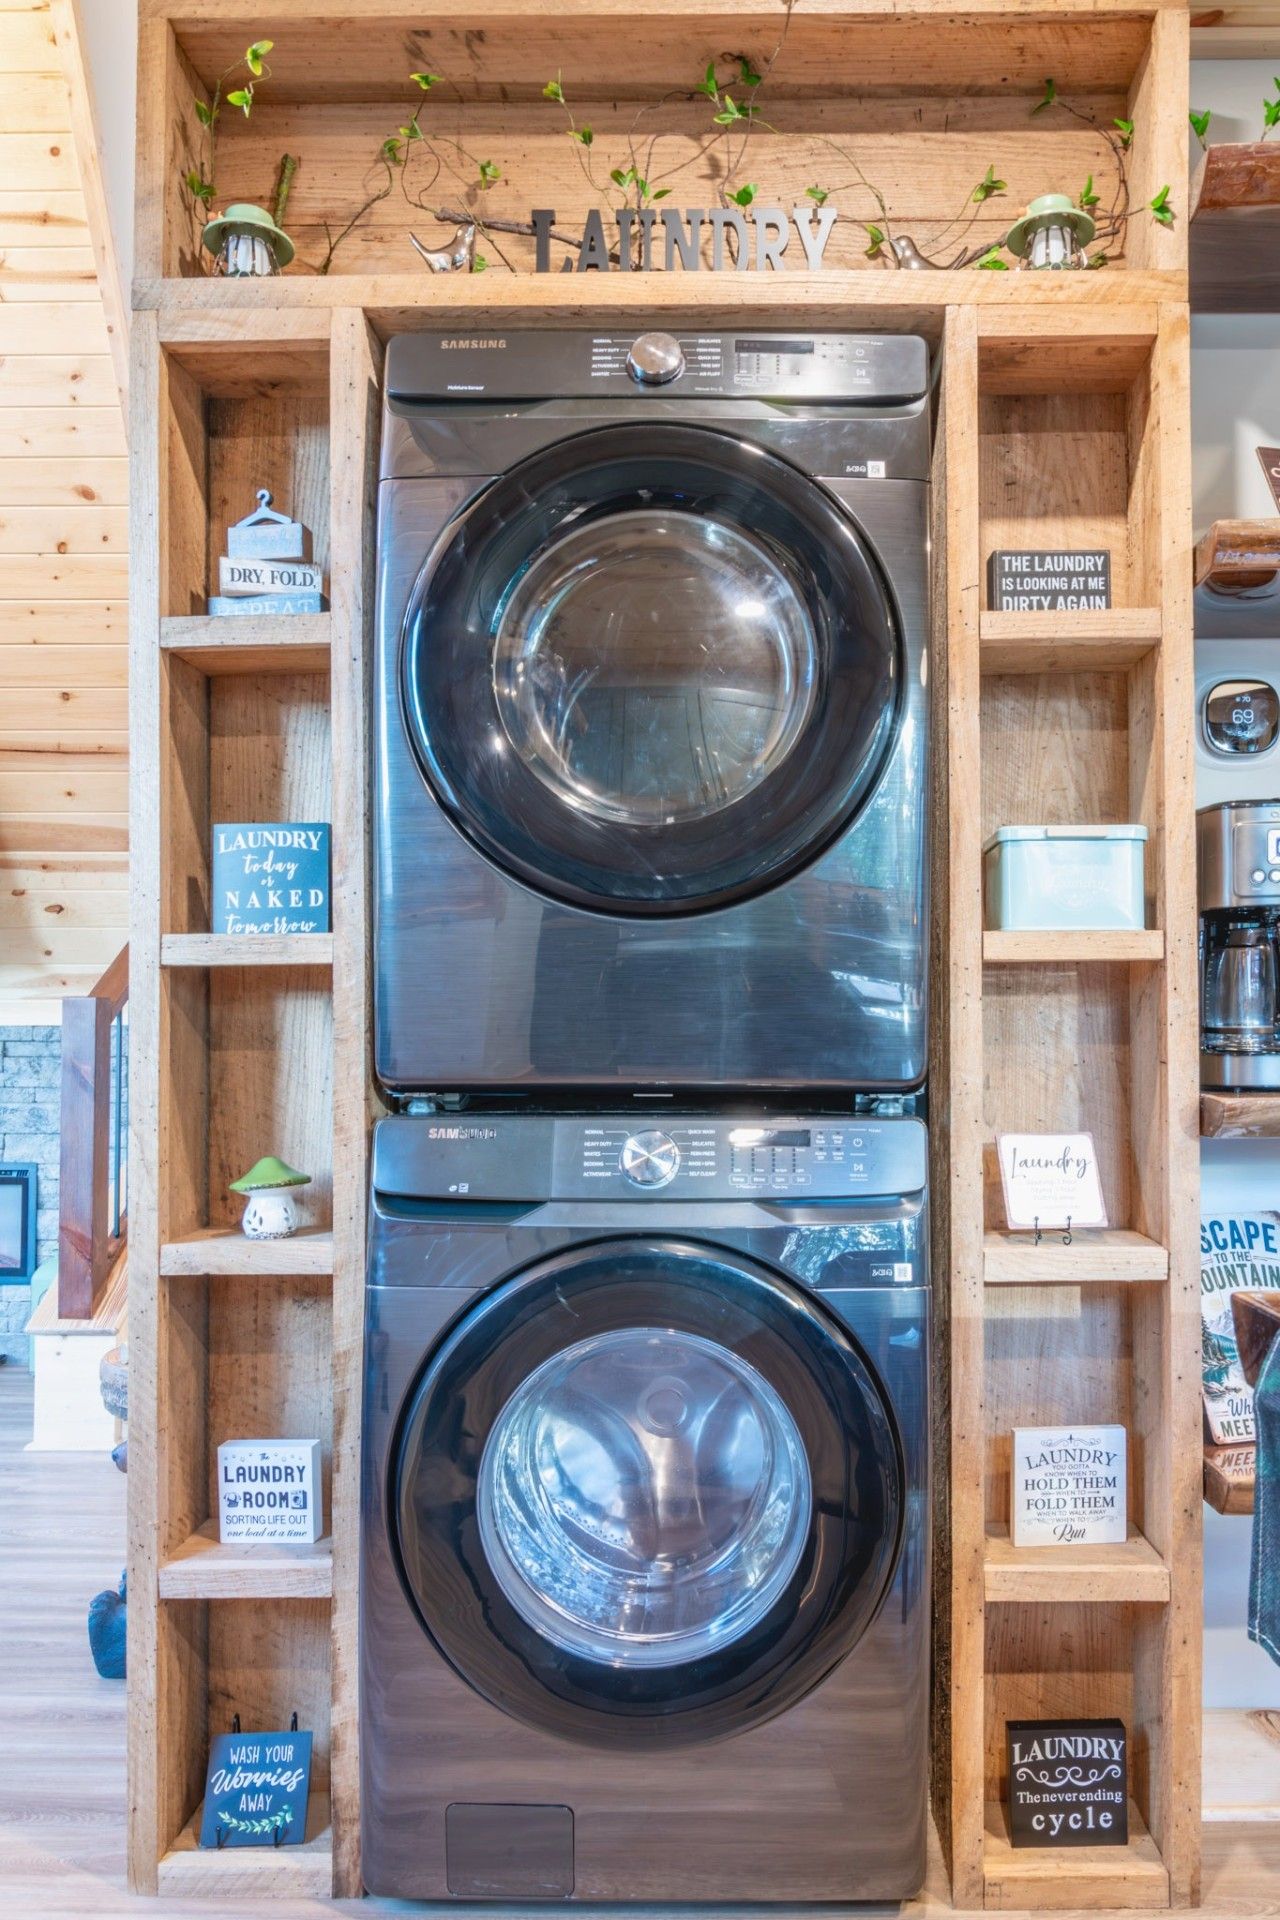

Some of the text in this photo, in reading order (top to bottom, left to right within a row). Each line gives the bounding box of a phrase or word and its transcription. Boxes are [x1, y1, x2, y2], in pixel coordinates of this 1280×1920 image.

[532, 208, 837, 272] LAUNDRY
[440, 340, 506, 349] SAMSUNG
[1002, 556, 1104, 572] THE LAUNDRY
[230, 568, 316, 589] DRY, FOLD,
[1002, 577, 1105, 590] IS LOOKING AT ME
[1002, 596, 1105, 611] DIRTY AGAIN
[1232, 709, 1254, 724] 69
[218, 830, 322, 854] LAUNDRY
[242, 850, 299, 880] today
[260, 876, 275, 887] or
[225, 889, 323, 909] NAKED
[225, 914, 317, 934] tomorrow
[1012, 1146, 1092, 1179] Laundry
[1201, 1220, 1278, 1253] SCAPE
[1214, 1251, 1252, 1263] TO THE
[1201, 1263, 1280, 1295] OUNTAIN
[1227, 1399, 1252, 1416] Wh
[1220, 1419, 1255, 1437] MEE
[1025, 1448, 1118, 1470] LAUNDRY
[224, 1466, 306, 1483] LAUNDRY
[1025, 1476, 1117, 1491] HOLD THEM
[243, 1492, 289, 1508] ROOM
[1026, 1496, 1115, 1510] FOLD THEM
[226, 1515, 307, 1525] SORTING LIFE OUT
[245, 1527, 267, 1537] load
[1053, 1524, 1086, 1542] Run
[230, 1745, 294, 1764] WASH YOUR
[1012, 1737, 1125, 1765] LAUNDRY
[211, 1766, 304, 1795] Worries
[239, 1793, 273, 1812] AWAY
[1017, 1792, 1040, 1804] The
[1032, 1806, 1112, 1836] cycle
